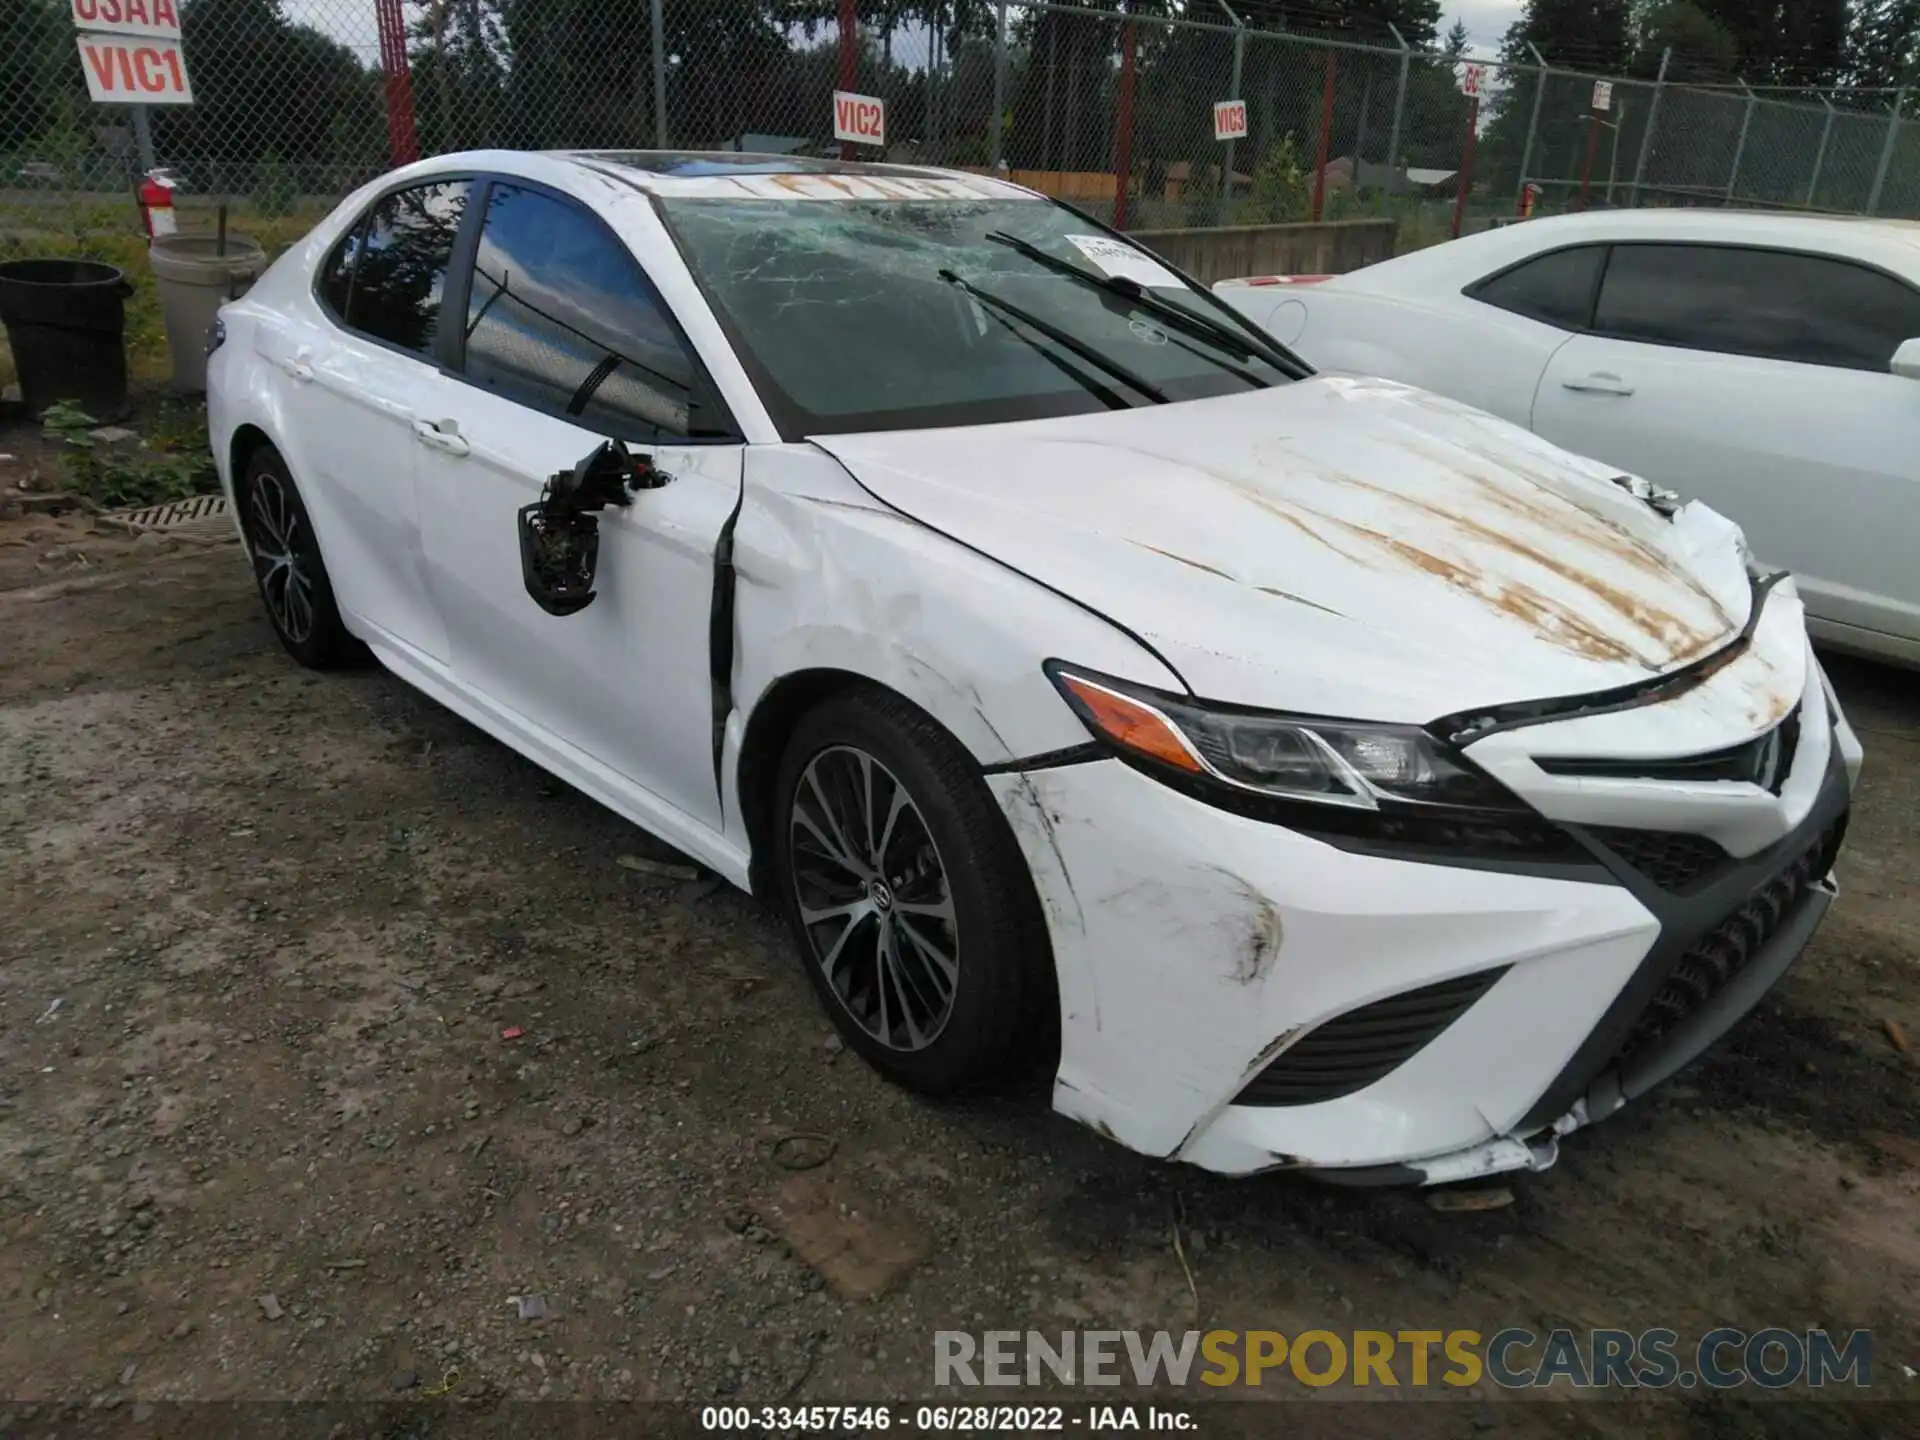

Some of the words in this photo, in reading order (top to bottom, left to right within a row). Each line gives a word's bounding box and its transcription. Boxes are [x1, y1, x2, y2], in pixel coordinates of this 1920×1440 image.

[84, 46, 184, 92] VIC1
[836, 99, 881, 137] VIC2
[1216, 105, 1245, 133] VIC3
